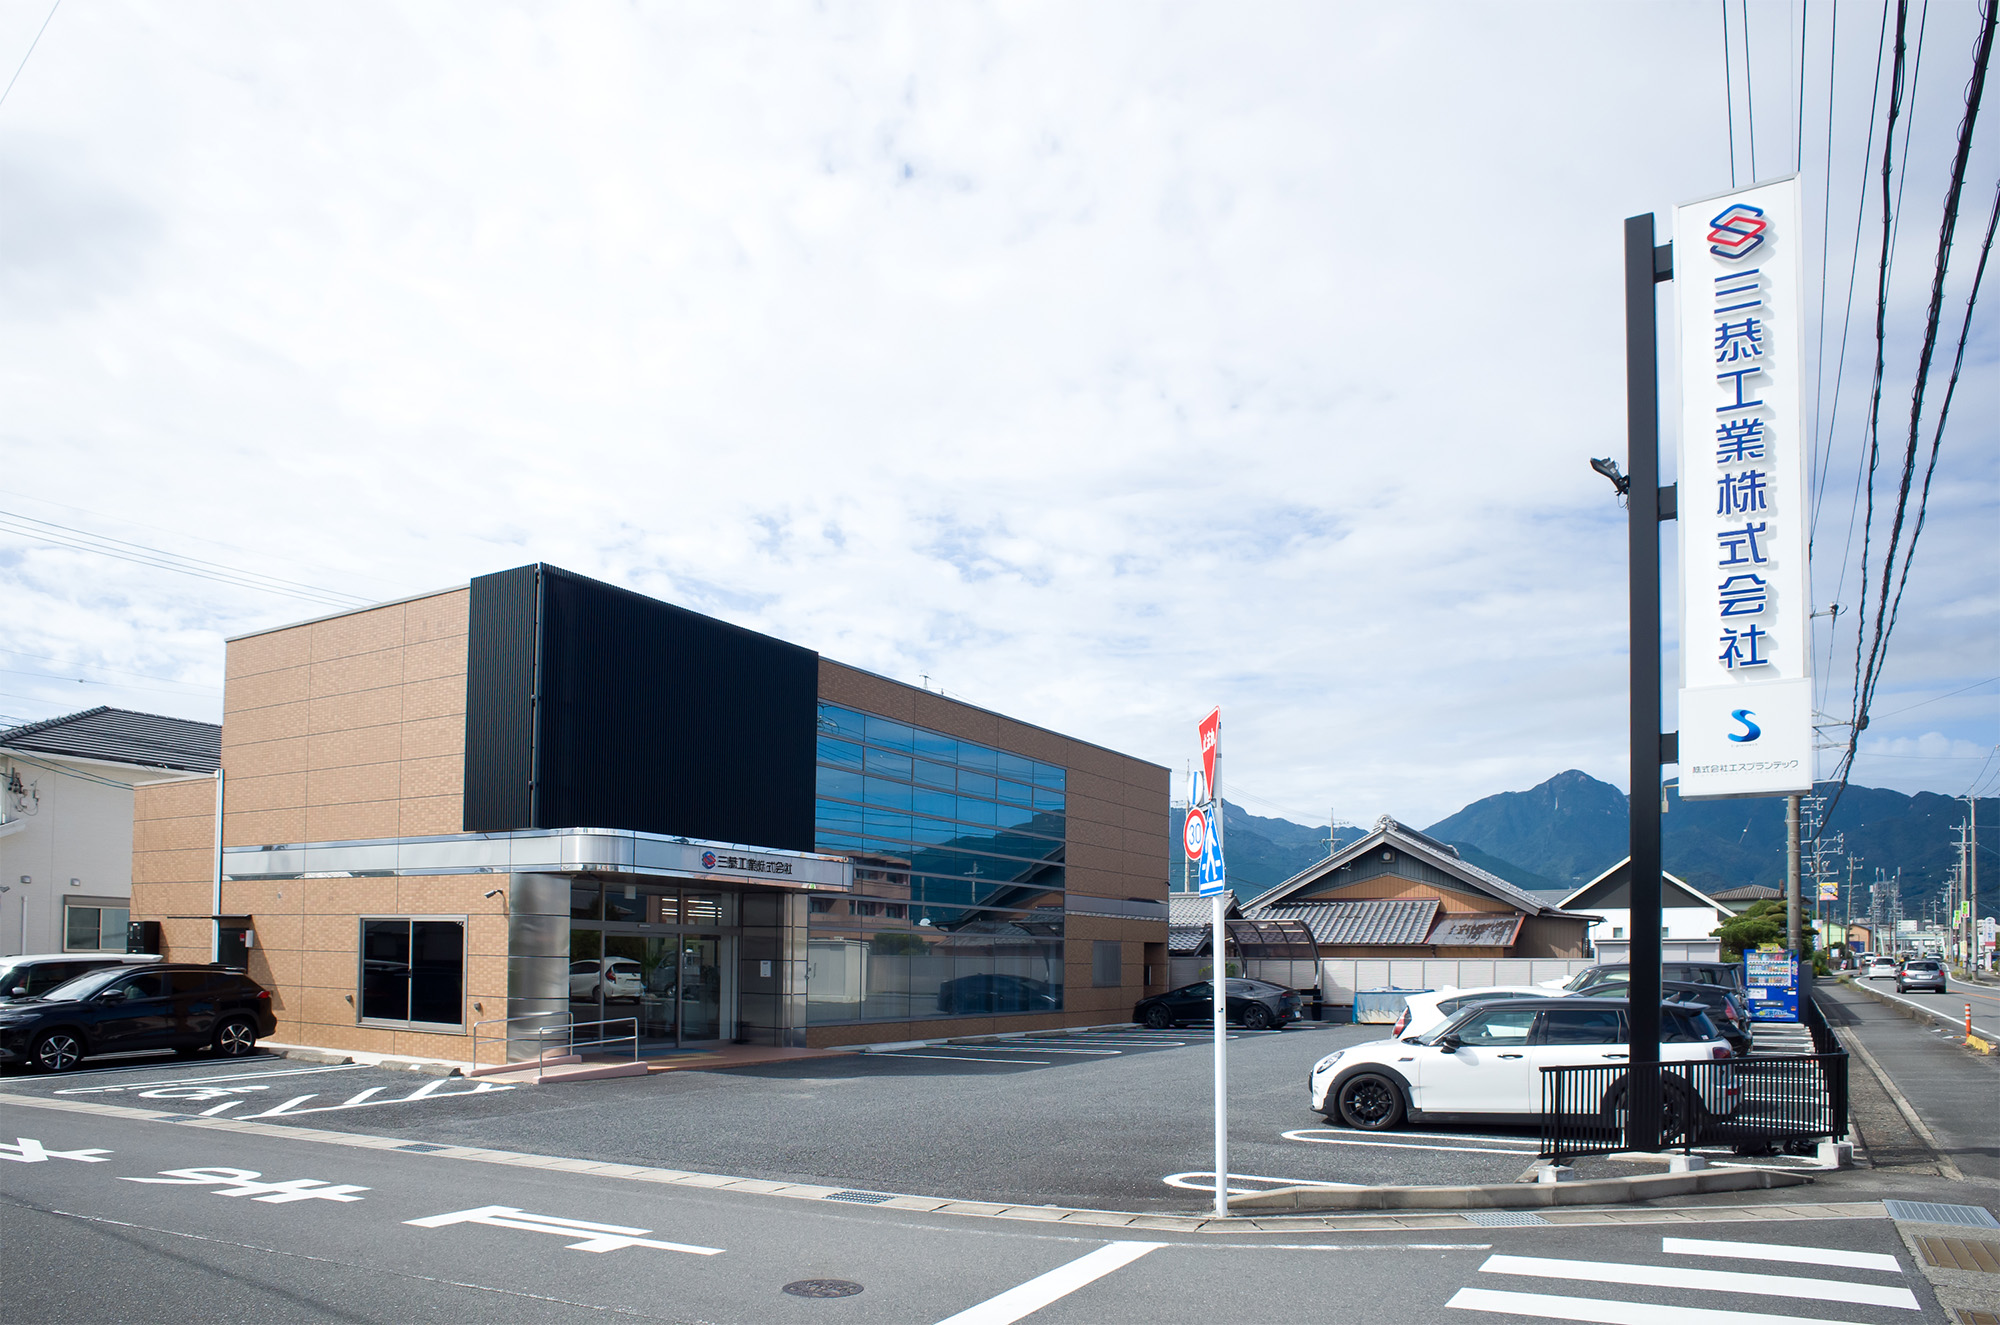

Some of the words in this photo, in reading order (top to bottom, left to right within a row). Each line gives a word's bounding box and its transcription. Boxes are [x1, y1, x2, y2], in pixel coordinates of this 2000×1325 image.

[1713, 268, 1769, 669] 三恭工業株式会社
[1203, 728, 1215, 753] 止まれ
[1188, 823, 1202, 845] 30
